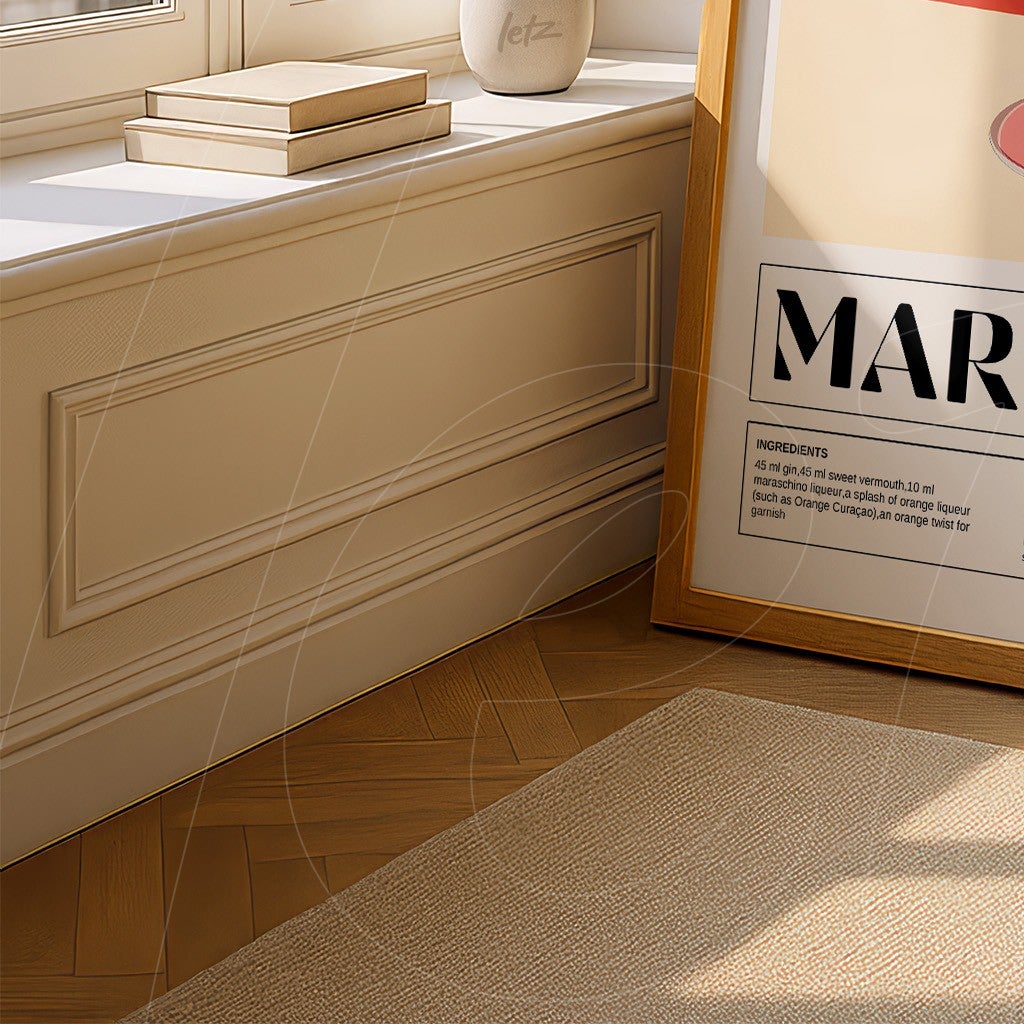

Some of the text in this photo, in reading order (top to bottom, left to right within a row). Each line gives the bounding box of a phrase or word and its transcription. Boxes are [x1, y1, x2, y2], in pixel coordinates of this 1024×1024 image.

[497, 11, 562, 53] letz
[756, 439, 828, 458] INGREDIENTS
[753, 476, 807, 492] maraschino
[853, 490, 885, 503] splash
[887, 494, 897, 505] of
[899, 497, 933, 512] orange
[936, 500, 970, 515] liqueur
[754, 459, 766, 470] 45
[768, 461, 780, 472] ml
[814, 468, 825, 479] ml
[827, 471, 856, 484] sweet
[922, 484, 934, 495] ml
[750, 506, 785, 519] garnish
[752, 489, 777, 503] (such
[780, 495, 791, 505] as
[794, 495, 830, 512] Orange
[893, 512, 928, 527] orange
[931, 517, 954, 529] twist
[956, 519, 970, 531] for
